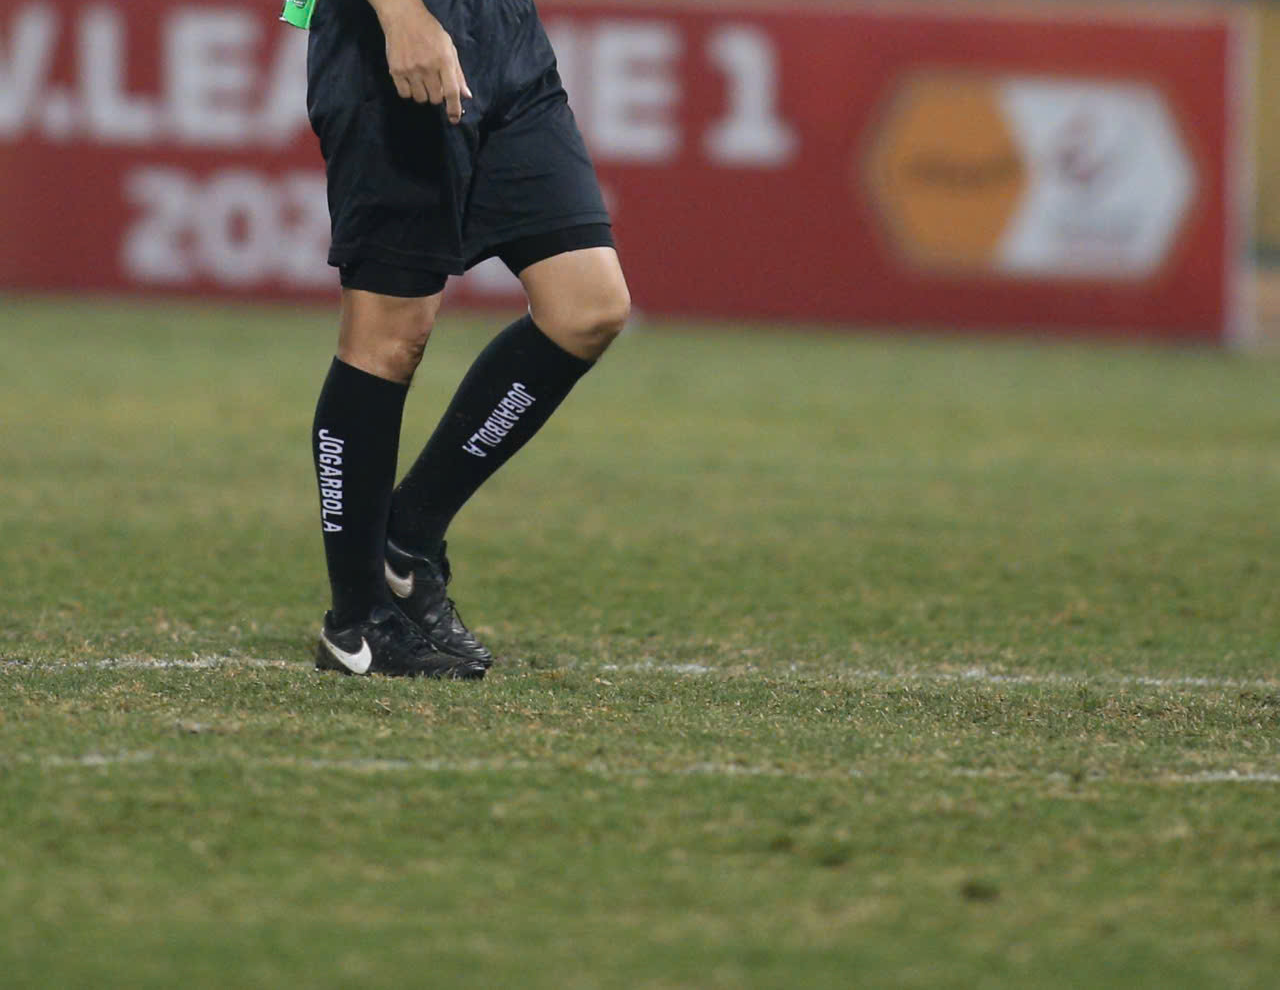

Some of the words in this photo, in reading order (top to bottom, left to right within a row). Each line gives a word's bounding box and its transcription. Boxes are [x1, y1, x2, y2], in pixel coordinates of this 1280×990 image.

[701, 24, 801, 168] 1
[462, 382, 536, 457] JOGARBOLA
[318, 428, 345, 533] JOGARBOLA
